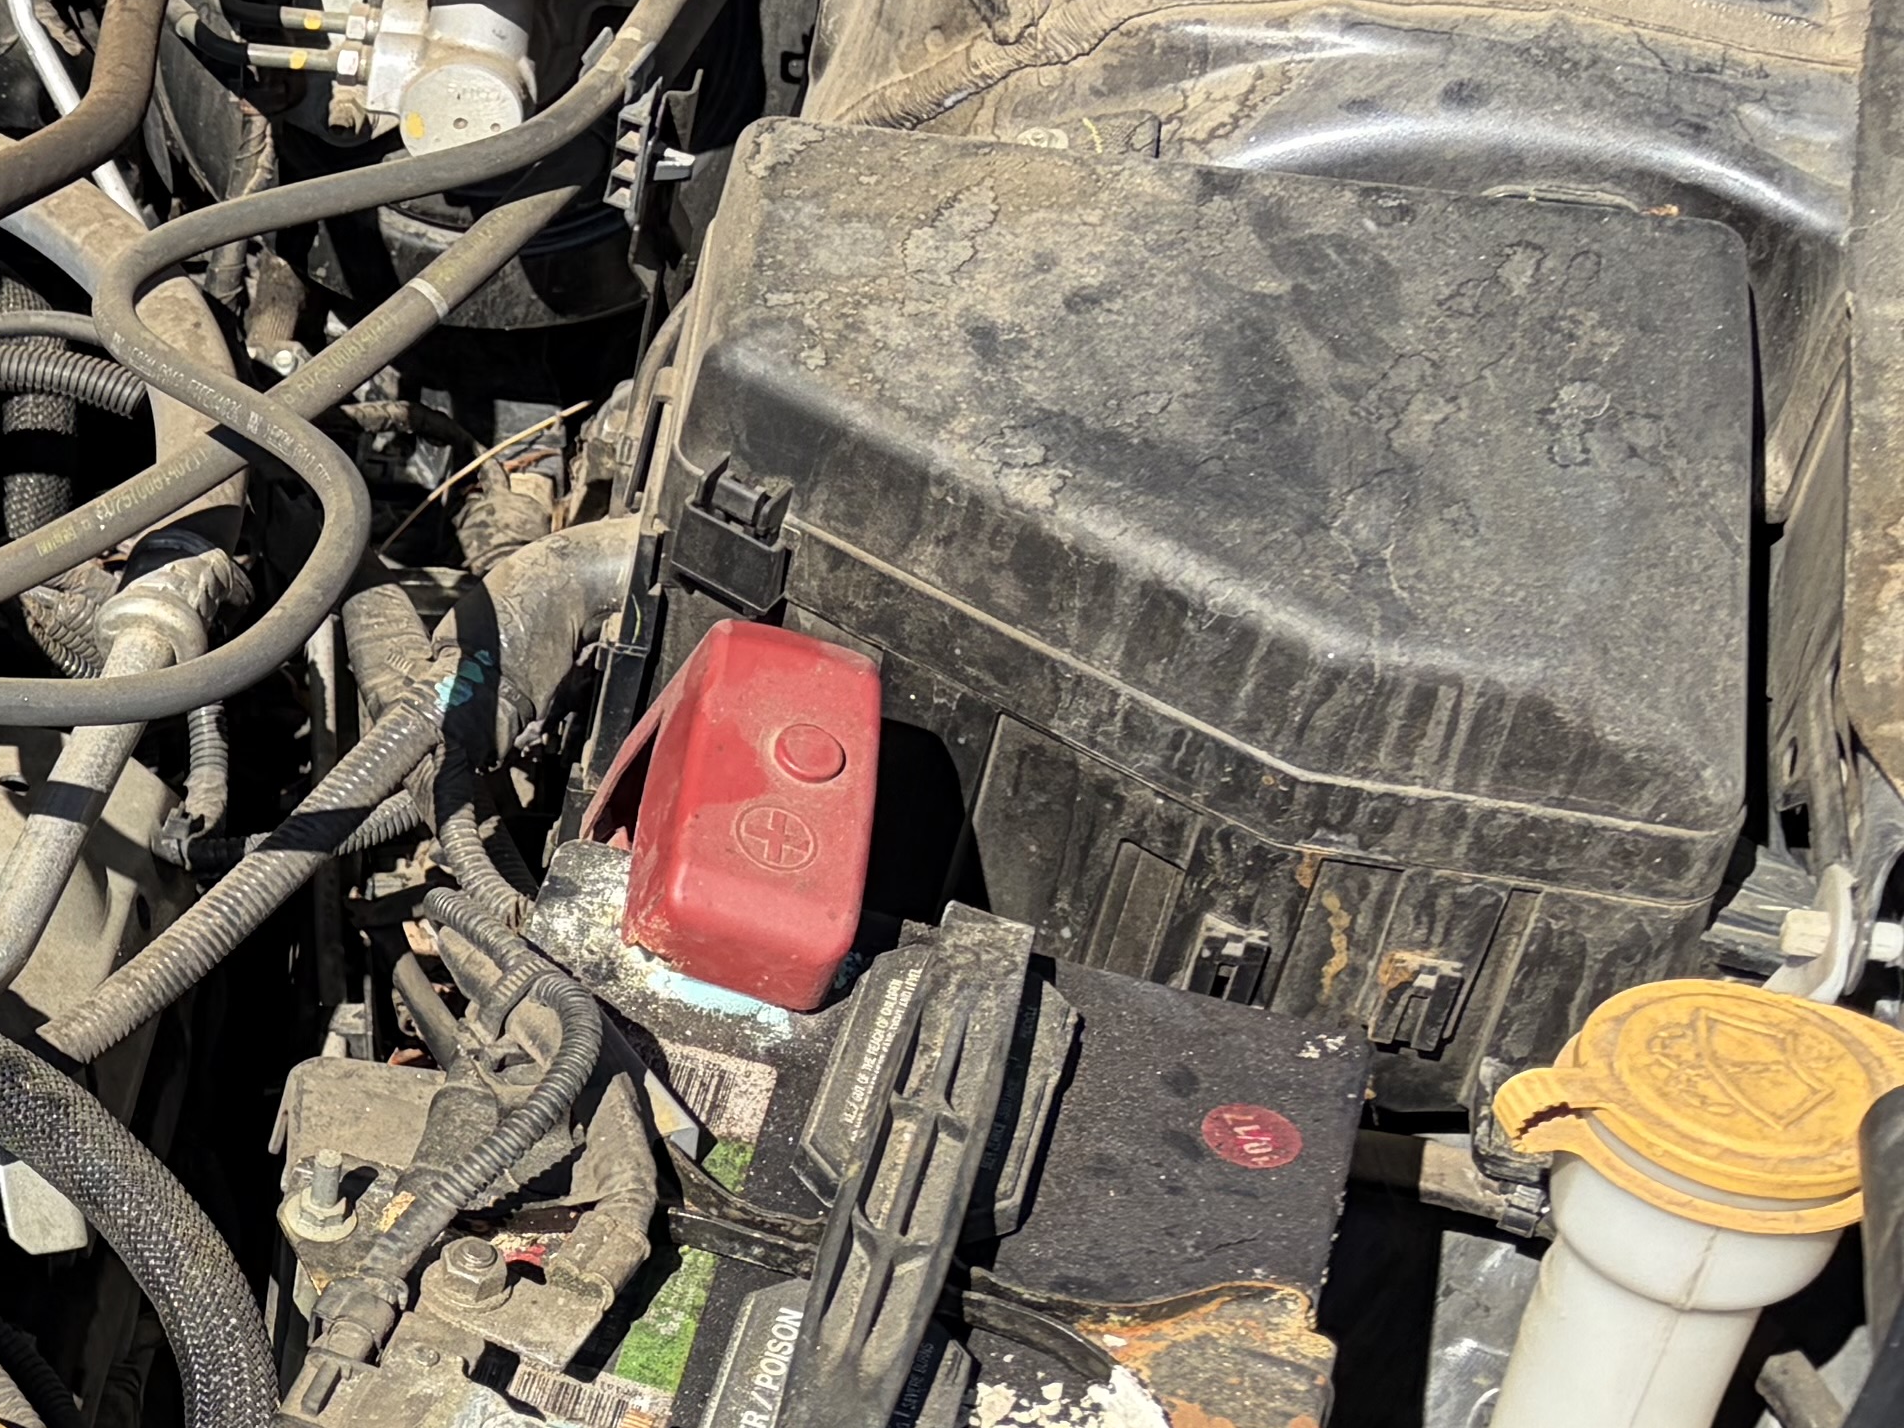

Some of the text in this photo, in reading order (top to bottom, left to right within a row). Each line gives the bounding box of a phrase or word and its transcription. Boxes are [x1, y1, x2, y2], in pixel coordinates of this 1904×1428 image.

[875, 1015, 889, 1029] OF
[860, 1055, 877, 1072] THE
[856, 1073, 870, 1084] OF
[754, 1307, 804, 1392] POISON
